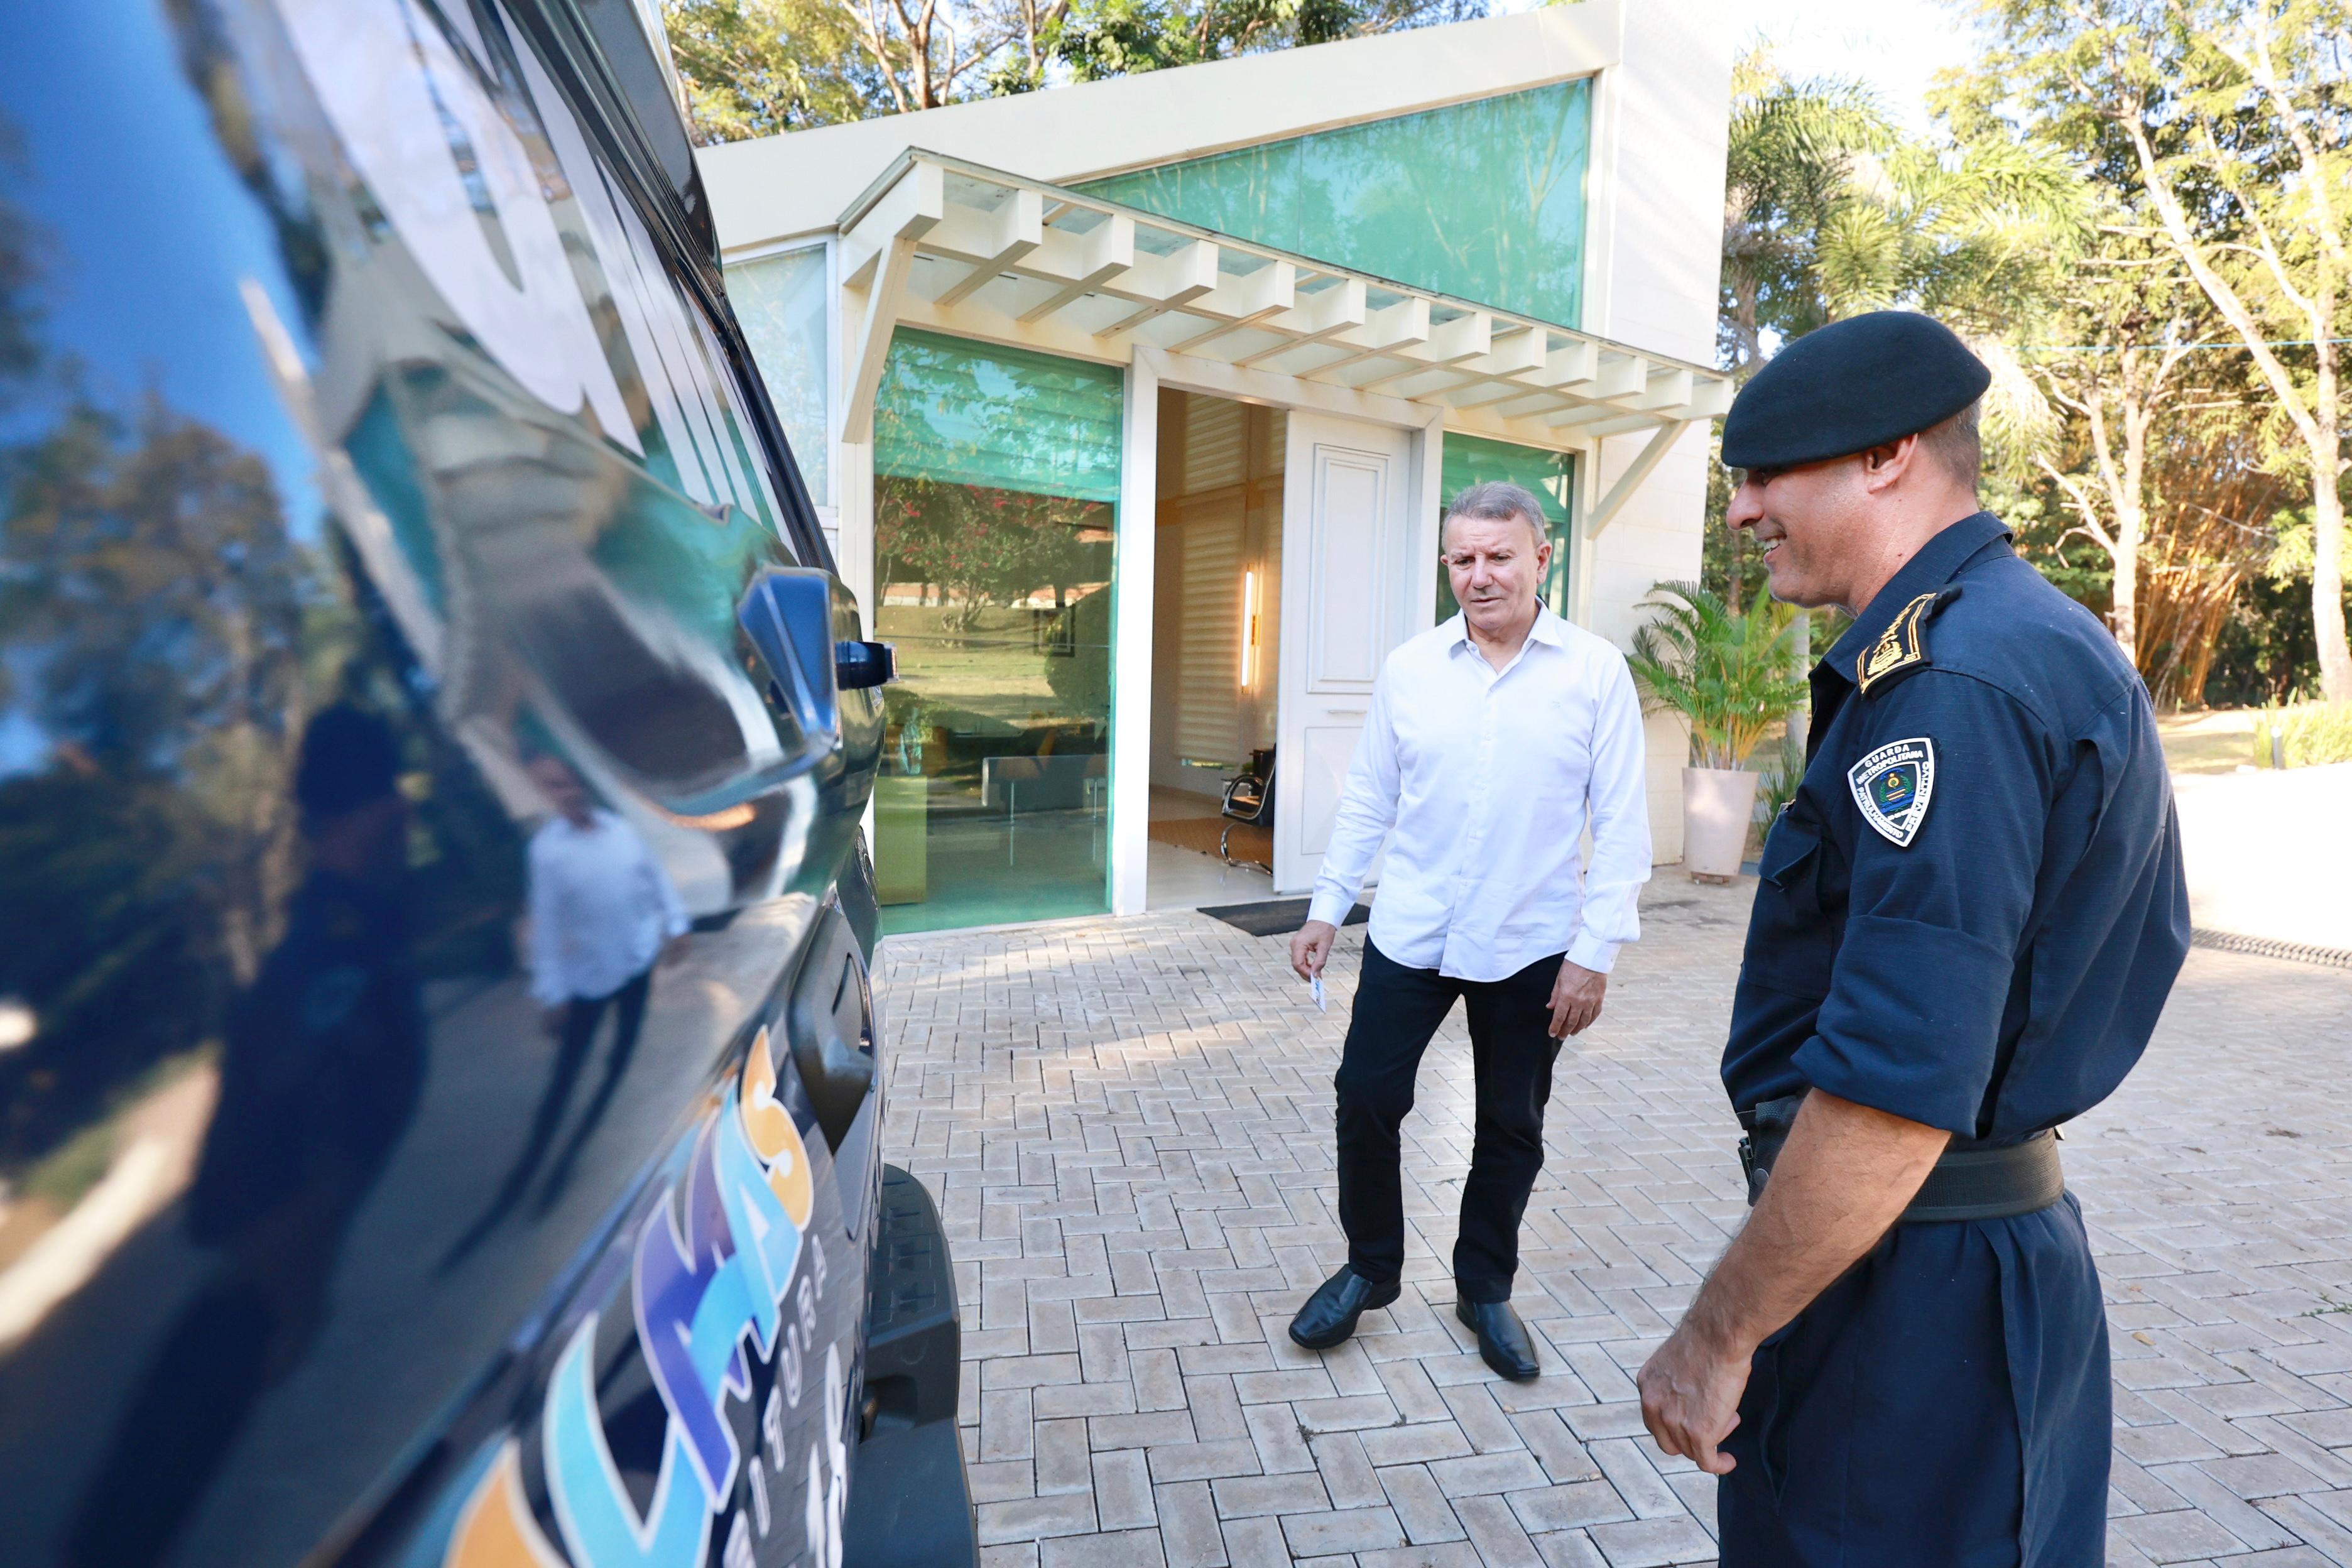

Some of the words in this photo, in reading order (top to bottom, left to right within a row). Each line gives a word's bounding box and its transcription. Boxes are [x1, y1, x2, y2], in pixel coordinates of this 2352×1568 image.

[1855, 749, 1924, 785] METROPOLITANA
[1865, 744, 1910, 768] GUARDA
[1856, 787, 1904, 839] PATRULHAMENTO
[1905, 761, 1929, 832] PREVENTIVO
[441, 1025, 814, 1568] LMAS
